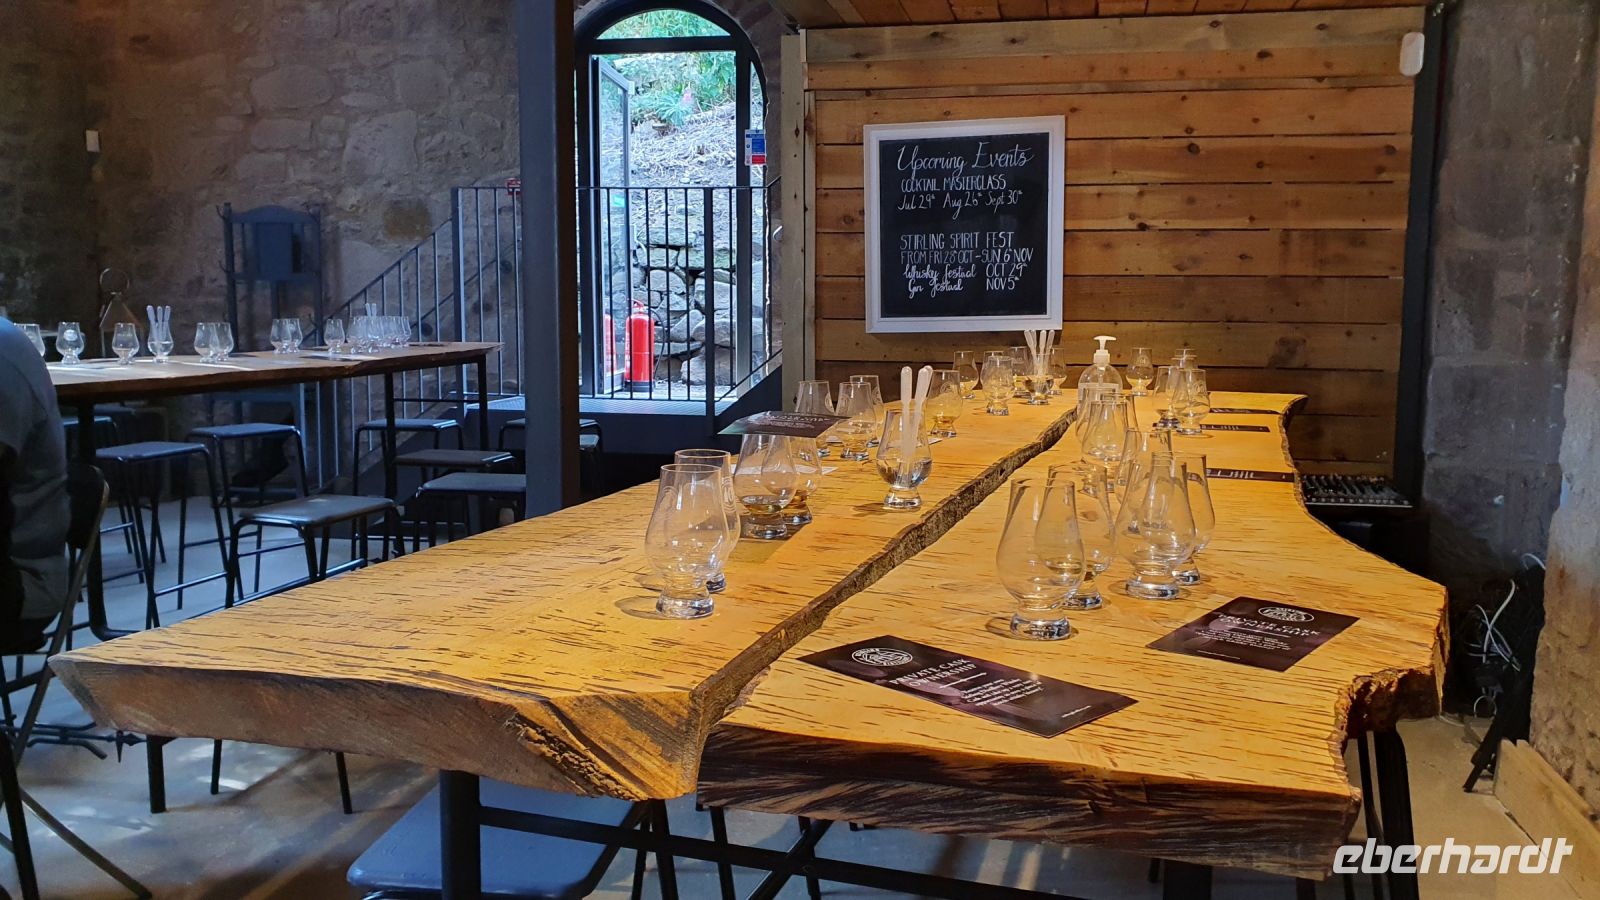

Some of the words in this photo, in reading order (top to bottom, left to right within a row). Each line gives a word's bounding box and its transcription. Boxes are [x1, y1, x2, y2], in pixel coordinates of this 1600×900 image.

[897, 145, 965, 179] Upcoming
[971, 141, 1034, 168] Events
[901, 178, 940, 192] COCKTAIL
[943, 174, 1007, 190] MASTERCLASS
[898, 194, 916, 210] Jul
[942, 192, 962, 220] Aug
[985, 190, 1005, 214] Sept
[900, 233, 945, 250] STIRLING
[950, 231, 980, 249] SPIRIT
[986, 231, 1015, 249] FEST
[901, 250, 926, 264] FROM
[929, 250, 943, 264] FRI
[957, 249, 974, 264] OCT
[1013, 247, 1034, 262] NOV
[903, 263, 939, 282] Whisky
[985, 262, 1007, 278] OCT
[986, 278, 1007, 291] NOV
[889, 668, 934, 685] PRIVATE
[938, 658, 971, 672] CASK
[908, 663, 977, 687] OWNERSHIP
